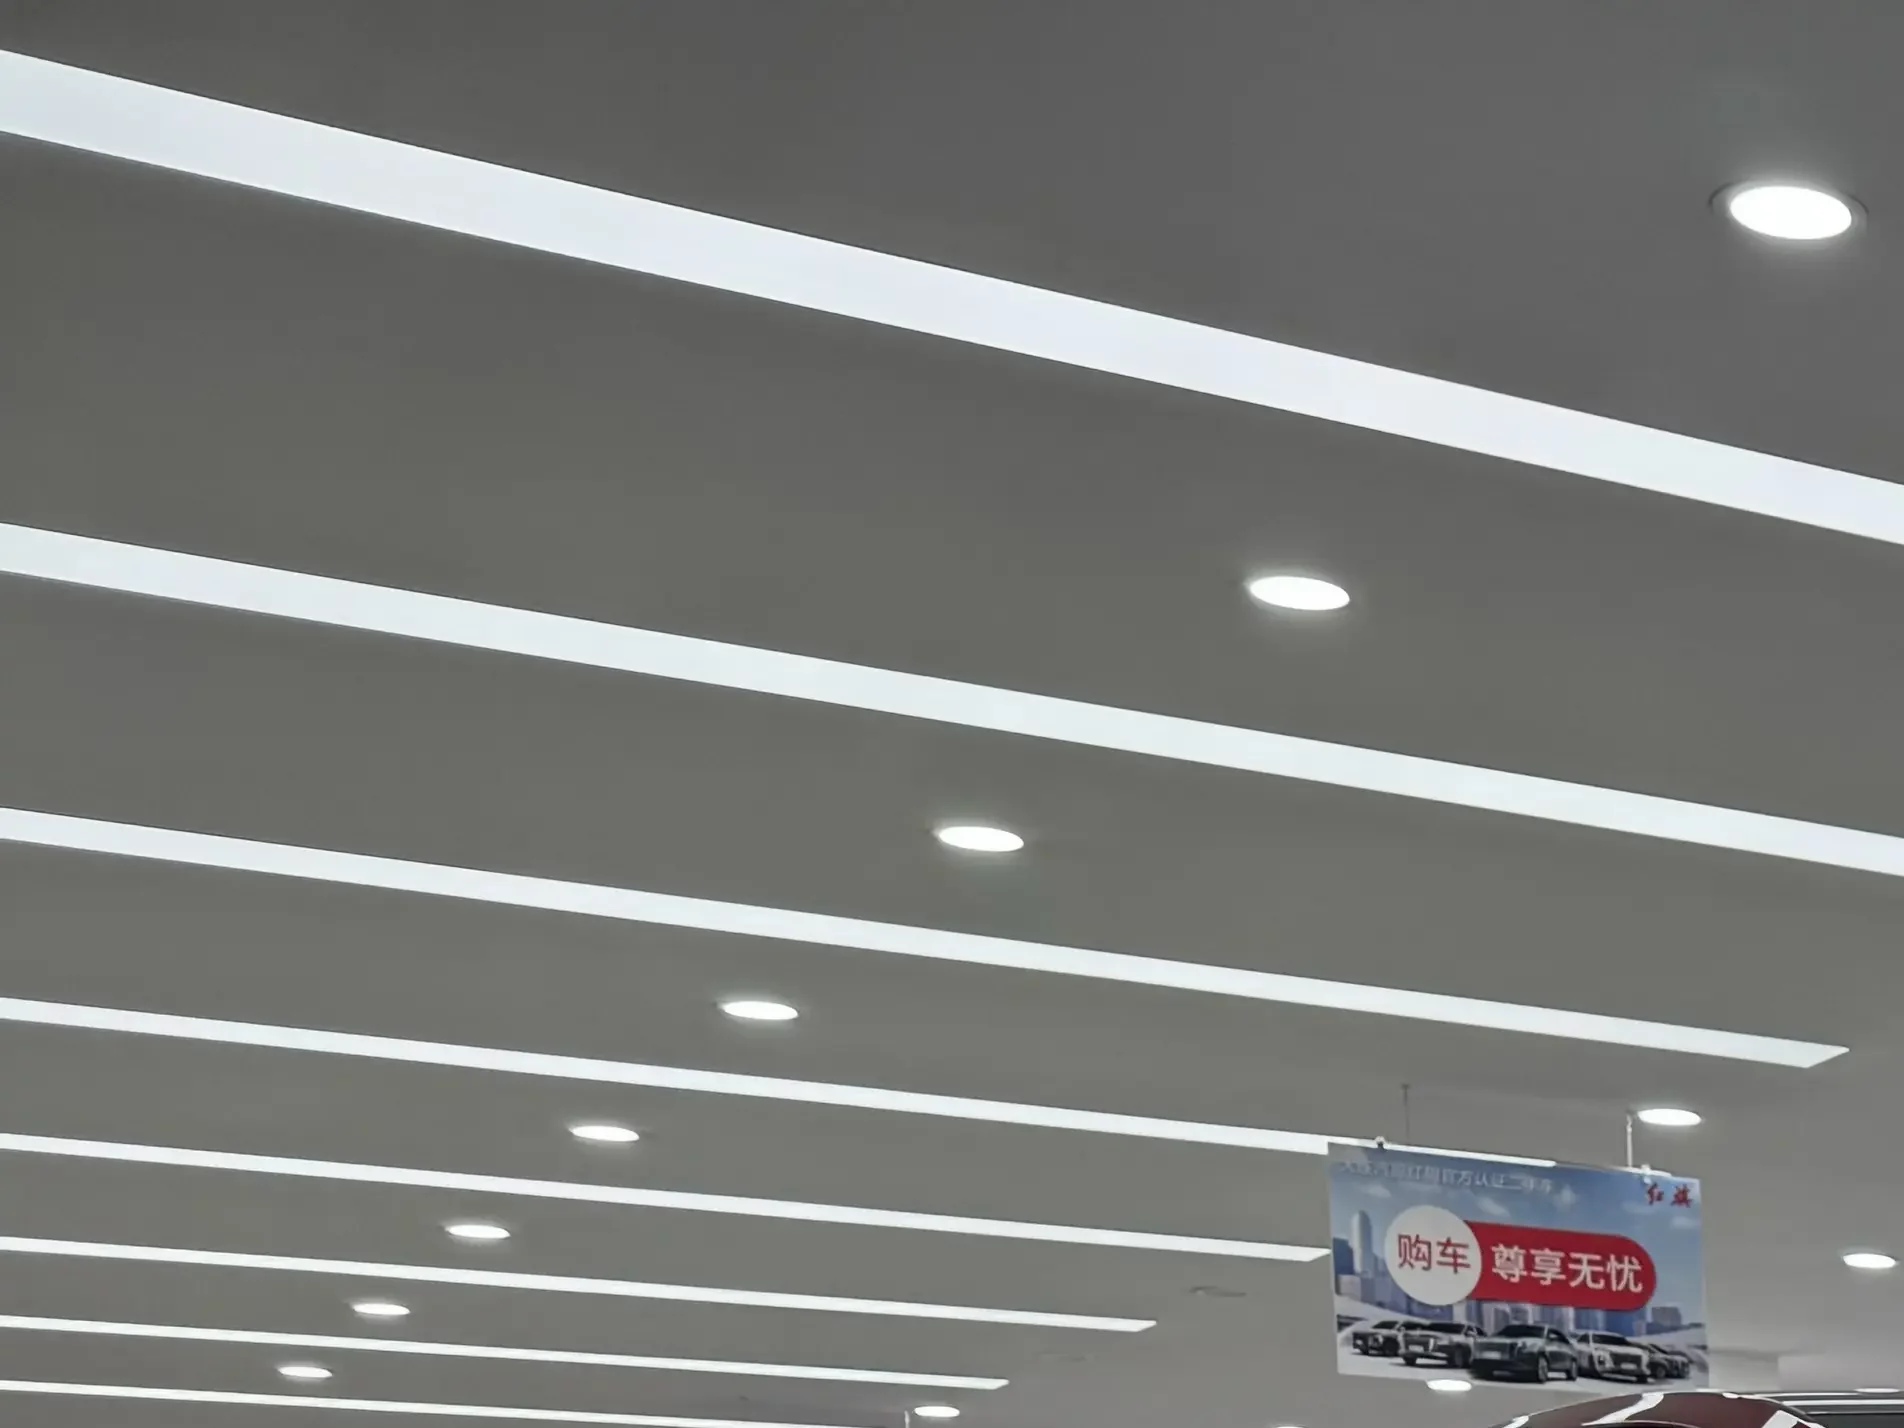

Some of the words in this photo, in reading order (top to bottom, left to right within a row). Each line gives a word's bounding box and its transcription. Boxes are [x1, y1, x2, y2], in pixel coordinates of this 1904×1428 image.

[1397, 1234, 1471, 1274] 购车
[1491, 1243, 1644, 1293] 尊享无忧
